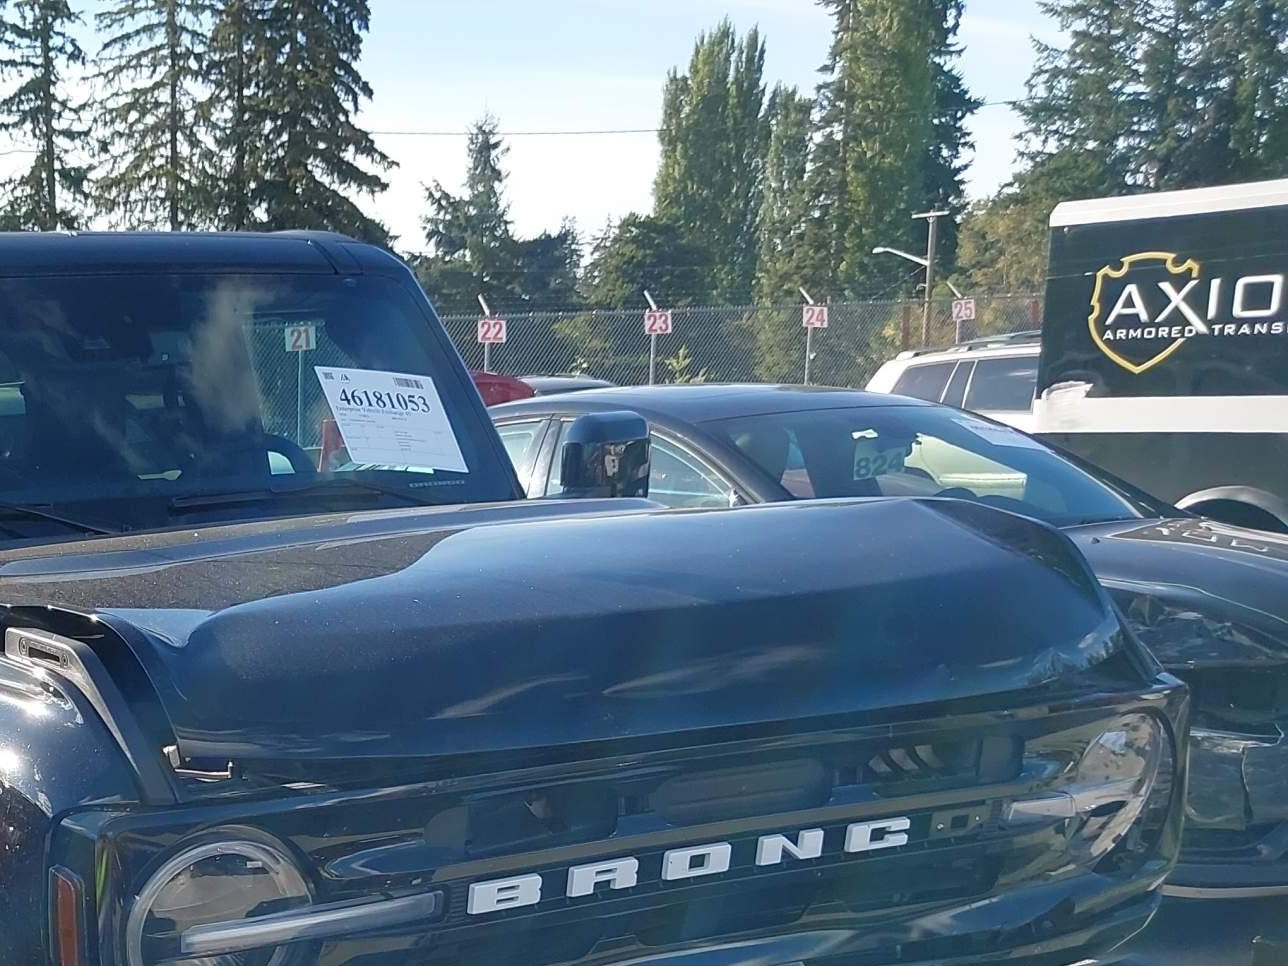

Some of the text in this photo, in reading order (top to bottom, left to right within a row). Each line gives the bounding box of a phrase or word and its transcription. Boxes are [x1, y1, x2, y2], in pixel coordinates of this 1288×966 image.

[954, 301, 973, 320] 25
[1105, 274, 1284, 334] AXIO
[647, 313, 669, 333] 23
[805, 307, 826, 327] 24
[290, 328, 311, 350] 21
[481, 321, 503, 342] 22
[1103, 321, 1288, 341] ARMORED TRANS
[339, 387, 431, 414] 46181053
